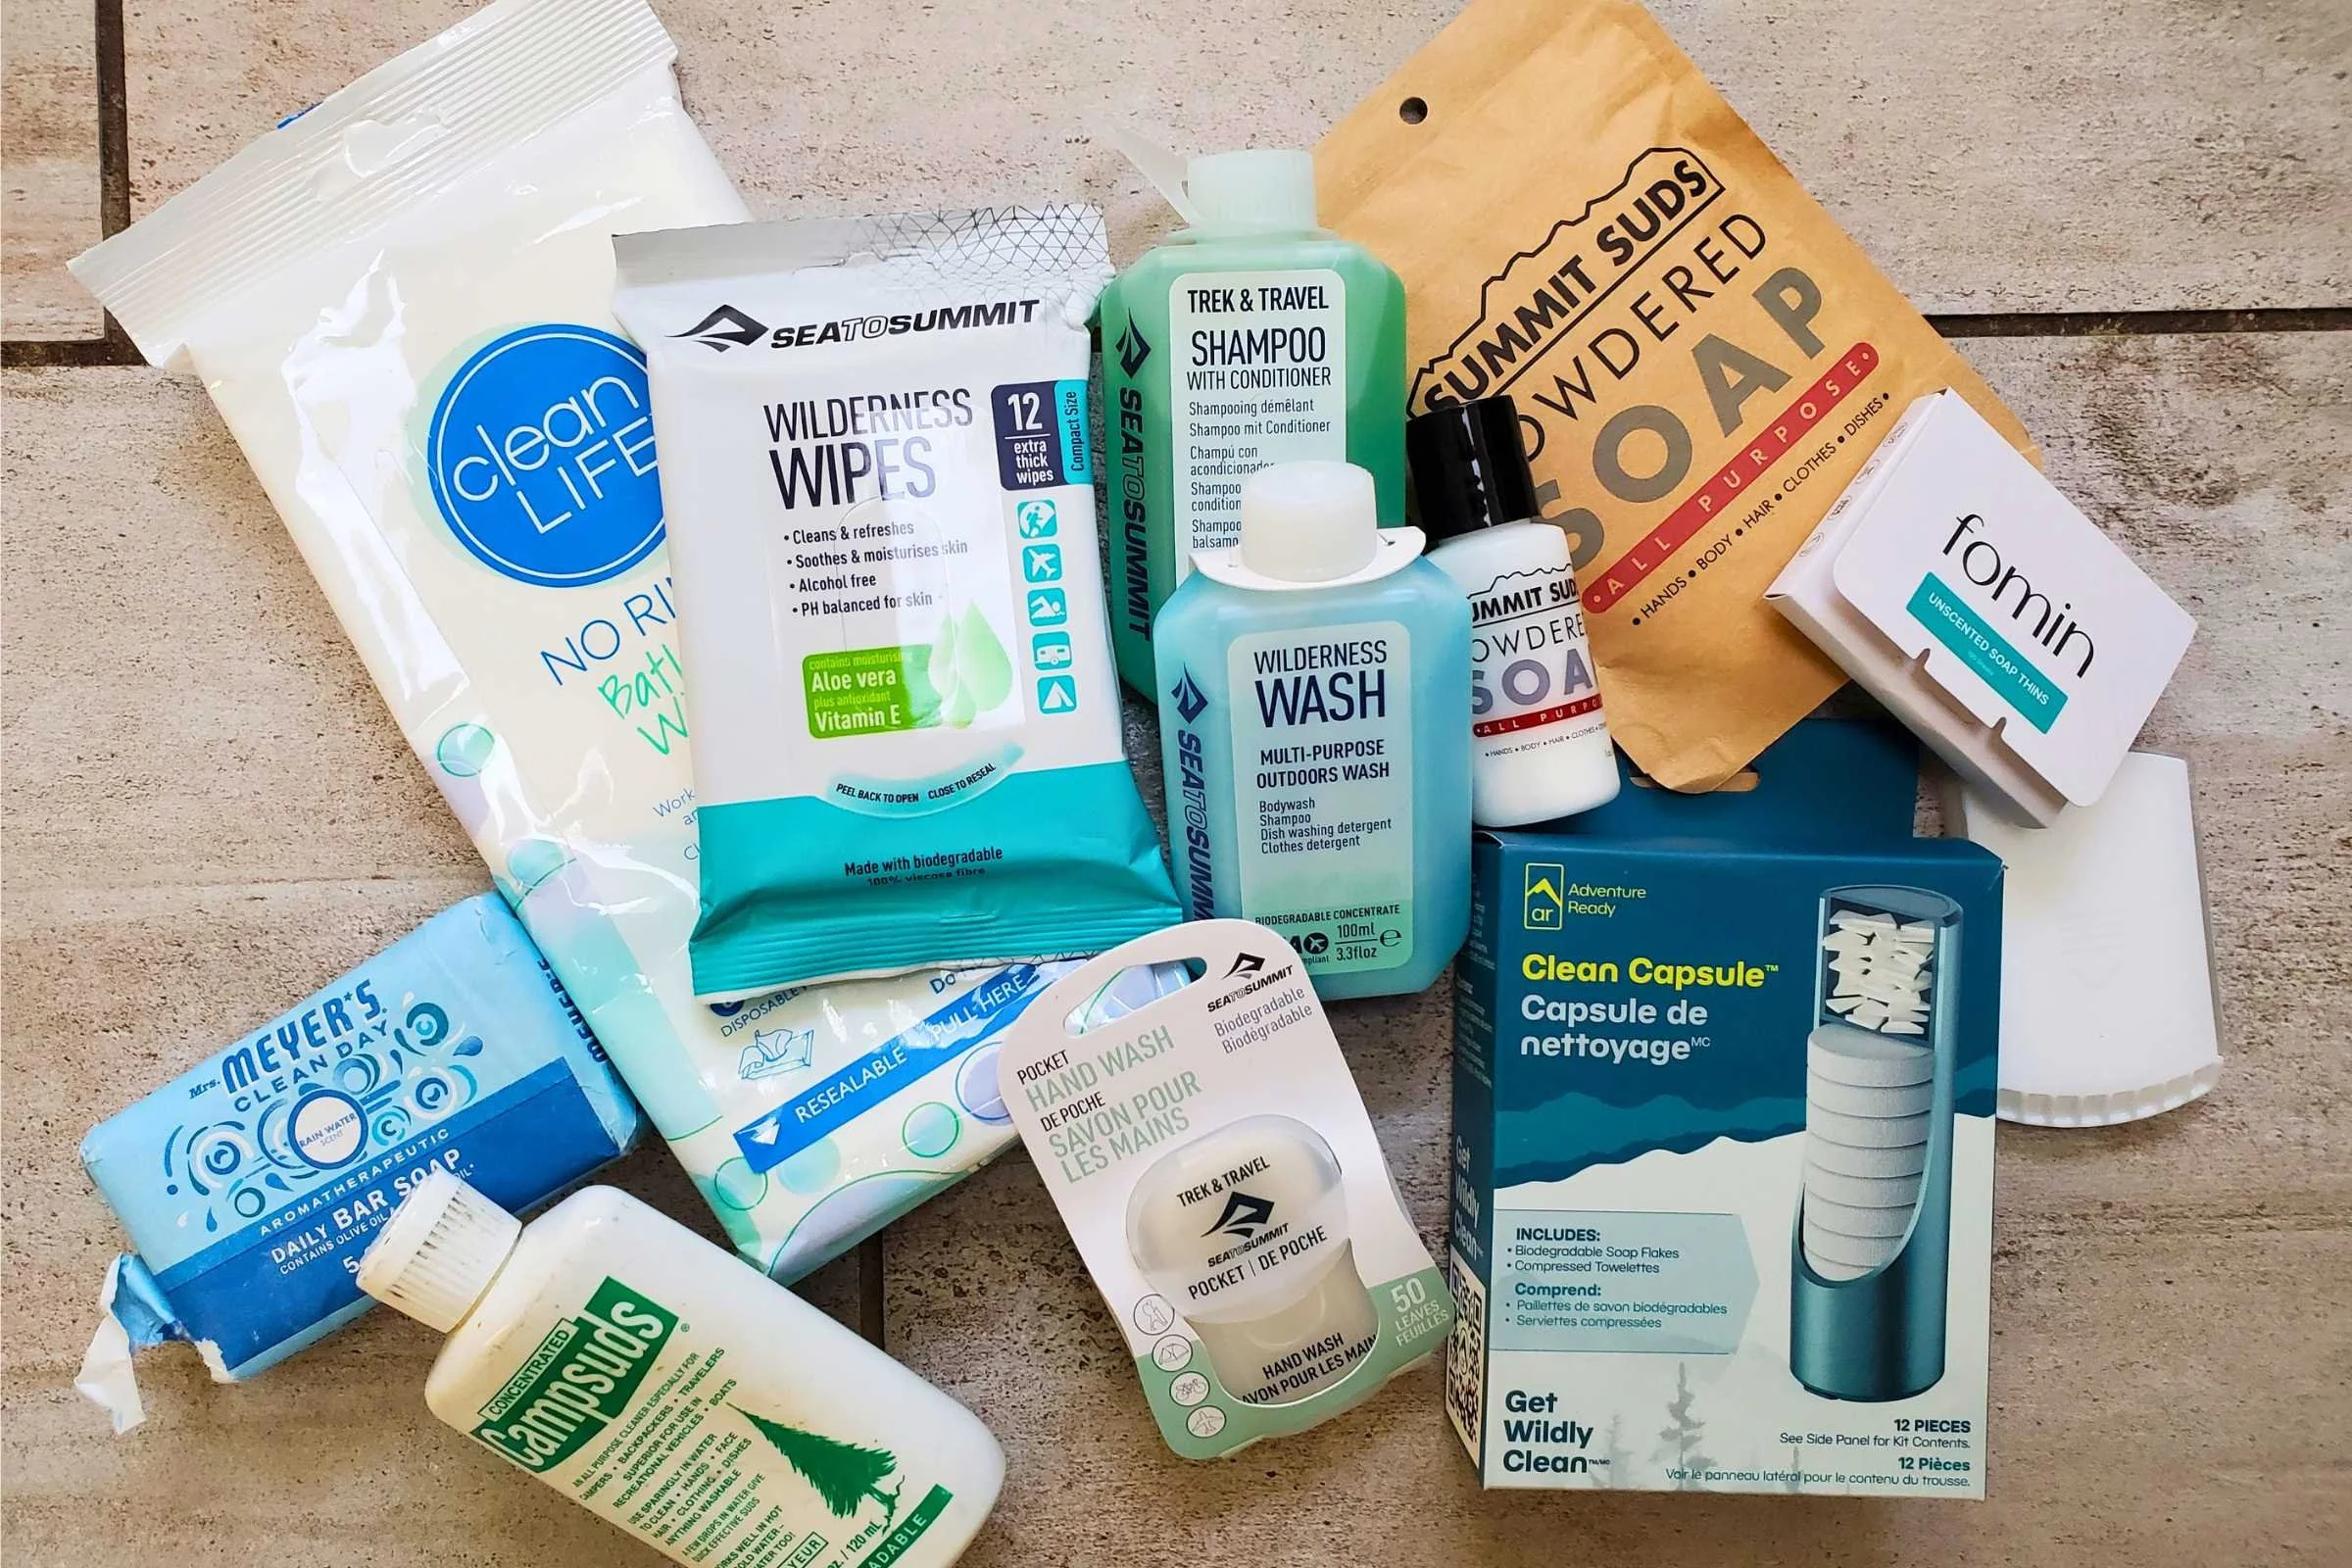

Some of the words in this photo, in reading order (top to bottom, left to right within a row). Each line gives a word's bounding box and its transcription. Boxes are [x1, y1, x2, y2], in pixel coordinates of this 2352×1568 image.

[1188, 289, 1235, 314] TREK
[1240, 288, 1253, 312] &
[1258, 286, 1329, 311] TRAVEL
[1425, 255, 1597, 412] SUMMIT
[1596, 160, 1707, 266] SUDS
[770, 300, 1040, 348] SEATOSUMMIT
[1192, 326, 1325, 366] SHAMPOO
[1187, 371, 1225, 390] WITH
[1231, 367, 1331, 390] CONDITIONER
[764, 388, 973, 442] WILDERNESS
[1007, 392, 1043, 430] 12
[1065, 392, 1078, 416] Size
[1189, 400, 1256, 417] Shampooing
[1261, 398, 1314, 413] démêlant
[454, 376, 640, 501] clean
[1067, 418, 1084, 470] Compact
[1190, 422, 1240, 439] Shampoo
[1245, 421, 1262, 434] mit
[1266, 420, 1330, 434] Conditioner
[1014, 439, 1047, 454] extra
[1016, 453, 1048, 468] thick
[1190, 445, 1235, 464] Champú
[1239, 447, 1257, 458] con
[516, 416, 657, 533] LIFE
[769, 437, 936, 510] WIPES
[1016, 469, 1054, 485] wipes
[1192, 481, 1241, 497] Shampoo
[1607, 537, 1671, 596] ALL
[1698, 359, 1862, 514] PURPOSE
[1641, 576, 1688, 618] HANDS
[1696, 534, 1734, 570] BODY
[1742, 499, 1775, 529] HAIR
[1783, 442, 1837, 493] CLOTHES
[1844, 398, 1884, 436] DISHES
[793, 527, 837, 544] Cleans
[841, 526, 849, 539] &
[854, 521, 914, 540] refreshes
[796, 550, 847, 568] Soothes
[852, 550, 860, 564] &
[864, 544, 939, 563] moisturises
[942, 540, 968, 555] skin
[800, 574, 848, 592] Alcohol
[852, 574, 876, 587] free
[1943, 514, 2094, 678] fomin
[802, 601, 818, 616] PH
[823, 596, 880, 613] balanced
[884, 595, 902, 609] for
[906, 591, 932, 607] skin
[540, 619, 620, 685] NO
[1254, 640, 1388, 674] WILDERNESS
[1929, 592, 1990, 652] UNSCENTED
[1988, 649, 2018, 676] SOAP
[2018, 672, 2049, 706] THINS
[812, 672, 852, 692] Aloe
[857, 669, 896, 688] vera
[1255, 669, 1385, 728] WASH
[814, 707, 885, 732] Vitamin
[891, 705, 901, 725] E
[1261, 739, 1384, 765] MULTI-PURPOSE
[1256, 767, 1338, 789] OUTDOORS
[1343, 762, 1390, 780] WASH
[1259, 797, 1315, 813] Bodywash
[1260, 813, 1311, 828] Shampoo
[1261, 829, 1285, 841] Dish
[1289, 823, 1334, 838] washing
[1338, 818, 1392, 833] detergent
[1261, 841, 1304, 854] Clothes
[1306, 836, 1360, 852] detergent
[845, 861, 879, 876] Made
[882, 857, 910, 871] with
[914, 847, 1003, 868] biodegradable
[1568, 884, 1646, 899] Adventure
[1334, 905, 1400, 919] CONCENTRATE
[1568, 902, 1615, 917] Ready
[1338, 923, 1375, 938] 100ml
[1522, 955, 1618, 982] Clean
[931, 1007, 978, 1040] PULL
[980, 975, 1026, 1012] HERE
[1214, 986, 1304, 1037] Biodegradable
[1521, 995, 1657, 1027] Capsule
[1667, 1000, 1707, 1026] de
[1222, 1004, 1312, 1054] Biodégradable
[234, 1054, 328, 1112] CLEAN
[336, 1020, 387, 1058] DAY
[1017, 1050, 1070, 1085] POCKET
[1026, 1061, 1099, 1111] HAND
[1098, 1025, 1174, 1077] WASH
[189, 1080, 220, 1100] Mrs.
[795, 1047, 907, 1123] RESEALABLE
[1041, 1112, 1060, 1132] DE
[1060, 1091, 1106, 1125] POCHE
[1049, 1102, 1132, 1158] SAVON
[1132, 1070, 1202, 1119] POUR
[299, 1130, 323, 1148] RAIN
[325, 1112, 358, 1134] WATER
[1060, 1147, 1108, 1184] LES
[1109, 1106, 1191, 1161] MAINS
[261, 1129, 449, 1236] AROMATHERAPEUTIC
[1177, 1180, 1213, 1207] TREK
[1212, 1178, 1223, 1193] &
[1222, 1156, 1270, 1188] TRAVEL
[270, 1224, 328, 1264] DAILY
[332, 1190, 389, 1229] BAR
[1516, 1228, 1600, 1242] INCLUDES:
[280, 1241, 334, 1274] CONTAINS
[336, 1222, 368, 1246] OLIVE
[1188, 1266, 1245, 1299] POCKET
[1258, 1251, 1279, 1271] DE
[1279, 1225, 1327, 1260] POCHE
[1515, 1246, 1602, 1257] Biodegradable
[1606, 1247, 1638, 1259] Soap
[1642, 1248, 1679, 1258] Flakes
[1515, 1260, 1592, 1273] Compressed
[1595, 1261, 1659, 1273] Towelettes
[1391, 1278, 1427, 1313] 50
[1515, 1283, 1601, 1298] Comprend:
[1396, 1299, 1440, 1330] LEAVES
[1517, 1300, 1571, 1311] Paillettes
[1575, 1300, 1590, 1311] de
[1593, 1303, 1630, 1312] savon
[1634, 1302, 1727, 1315] biodégradables
[1396, 1309, 1449, 1347] FEUILLES
[481, 1301, 663, 1466] Campsuds
[489, 1329, 570, 1415] CONCENTRATED
[617, 1405, 673, 1464] BACKPACKERS
[679, 1348, 724, 1396] TRAVELERS
[1505, 1390, 1558, 1412] Get
[1503, 1420, 1593, 1448] Wildly
[1780, 1433, 1803, 1444] See
[1807, 1434, 1833, 1446] Side
[1836, 1435, 1869, 1446] Panel
[1874, 1436, 1888, 1447] for
[1893, 1437, 1908, 1447] Kit
[1912, 1437, 1970, 1448] Contents.
[1894, 1419, 1910, 1432] 12
[1914, 1420, 1970, 1433] PIECES
[612, 1453, 668, 1508] RECREATIONAL
[665, 1413, 705, 1453] VEHICLES
[709, 1379, 737, 1406] BOATS
[1898, 1457, 1914, 1470] 12
[1919, 1457, 1970, 1472] Pièces
